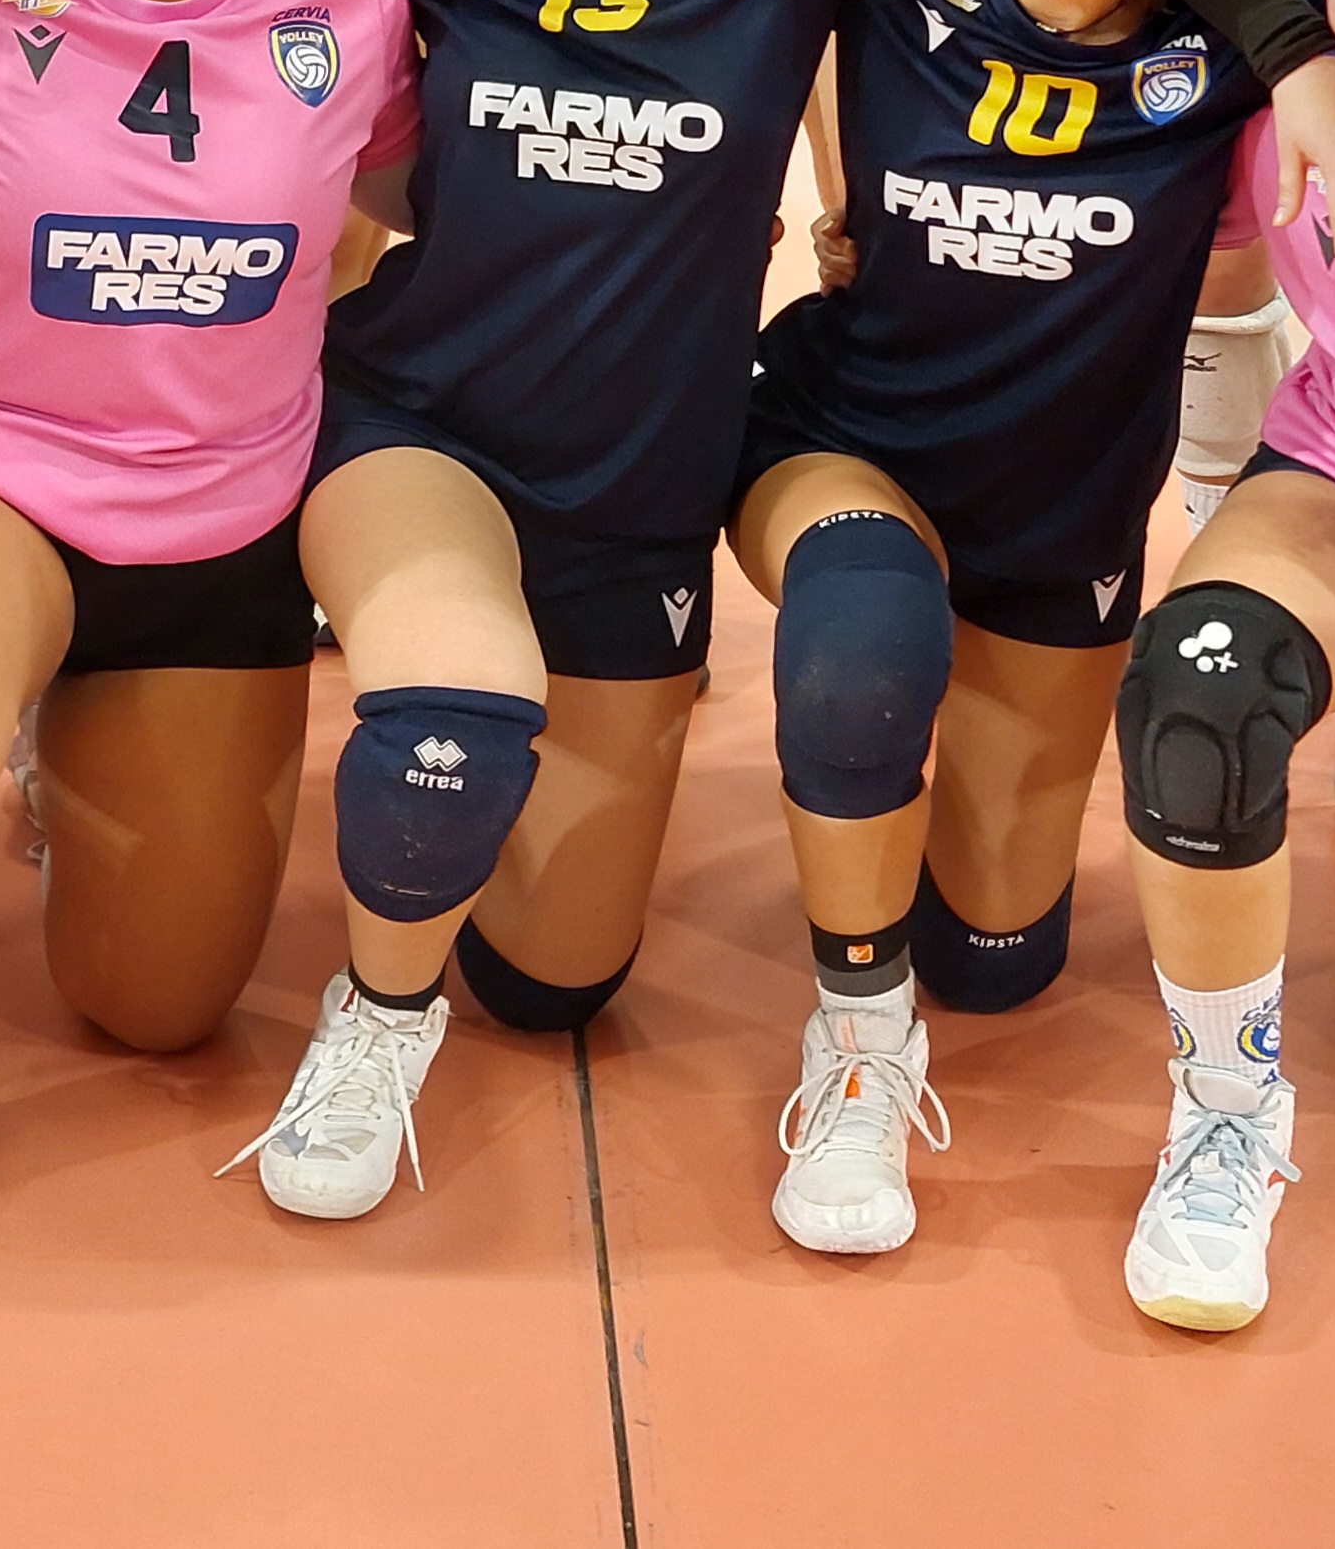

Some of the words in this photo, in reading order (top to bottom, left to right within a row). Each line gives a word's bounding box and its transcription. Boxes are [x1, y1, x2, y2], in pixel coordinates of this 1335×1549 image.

[272, 6, 331, 23] CERVIA
[278, 30, 323, 45] VOLLEY
[1144, 61, 1196, 75] VOLLEY
[118, 40, 200, 163] 4
[469, 81, 724, 153] FARMO
[968, 60, 1098, 156] 10
[517, 133, 665, 192] RES
[883, 169, 1134, 246] FARMO
[47, 229, 285, 278] FARMO
[928, 225, 1073, 282] RES
[91, 271, 228, 316] RES
[404, 767, 465, 792] errea
[968, 933, 1025, 949] KIPSTA
